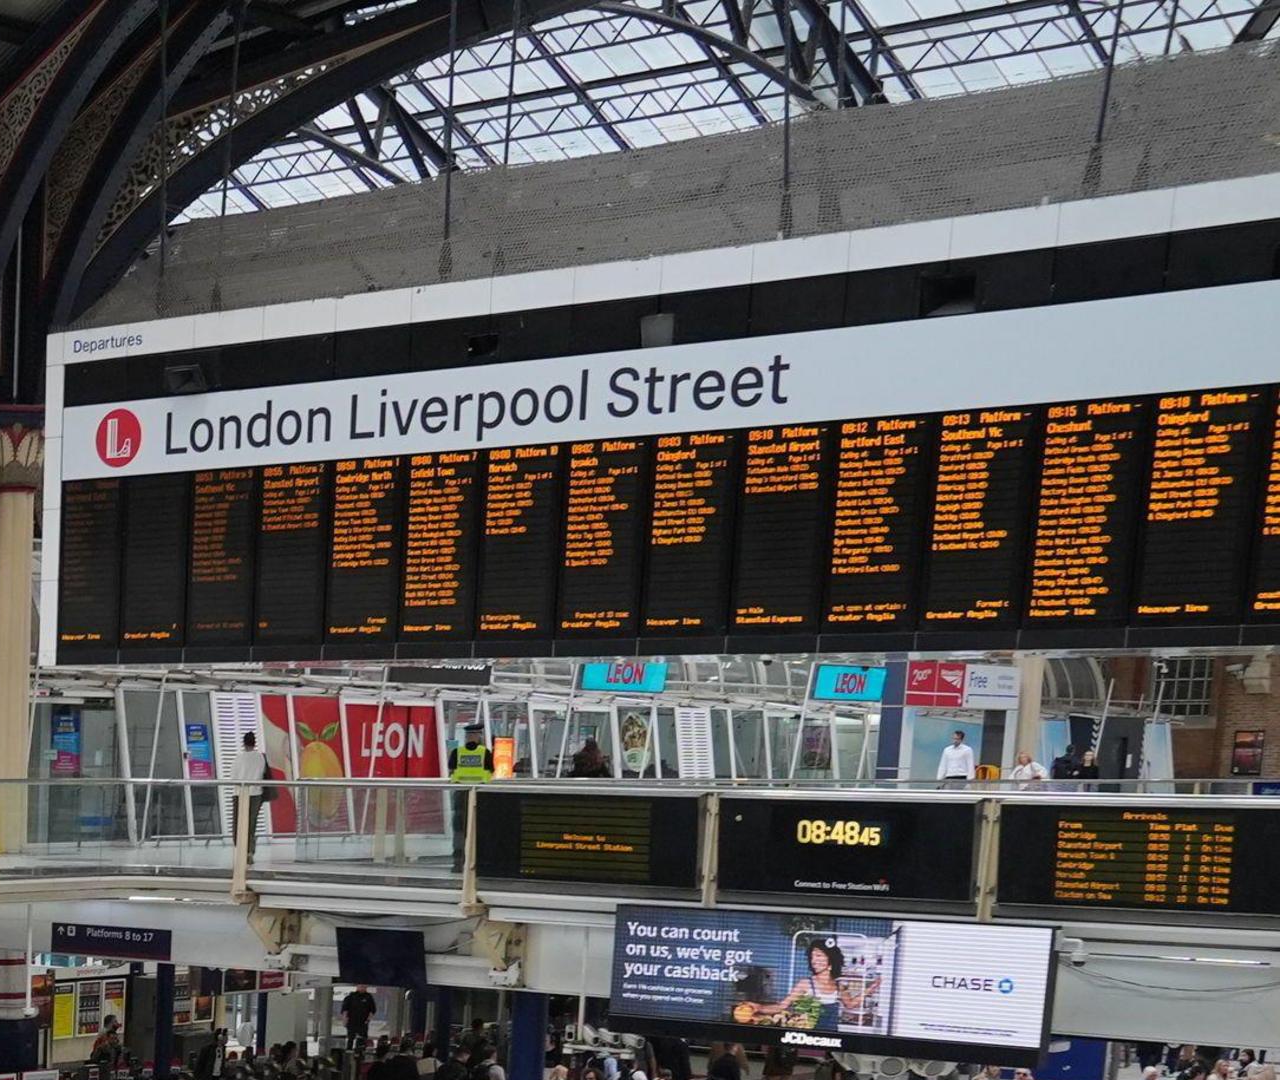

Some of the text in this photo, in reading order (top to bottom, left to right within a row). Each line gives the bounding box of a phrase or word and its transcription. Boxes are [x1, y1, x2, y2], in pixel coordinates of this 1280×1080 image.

[73, 332, 143, 354] Departures
[164, 354, 790, 455] London Liverpool Street
[1201, 394, 1247, 406] Platform
[1087, 403, 1131, 415] Platform
[877, 420, 916, 431] Platform
[980, 412, 1021, 423] Platform
[1158, 410, 1210, 425] Chingford
[782, 427, 819, 438] Platform
[1047, 420, 1092, 433] Cheshunt
[602, 441, 635, 452] Platform
[690, 435, 725, 445] Platform
[883, 434, 905, 445] East
[606, 661, 645, 684] LEON
[970, 672, 988, 689] Free
[834, 672, 867, 694] LEON
[360, 721, 425, 758] LEON
[794, 880, 821, 888] Connect
[831, 881, 847, 890] Free
[847, 882, 873, 891] Station
[86, 926, 154, 942] Platforms 8 to 17
[627, 921, 740, 943] You can count
[626, 943, 753, 965] on us, we've got
[623, 960, 739, 982] your cashback
[932, 975, 994, 992] CHASE
[781, 1031, 842, 1048] JCDecaux
